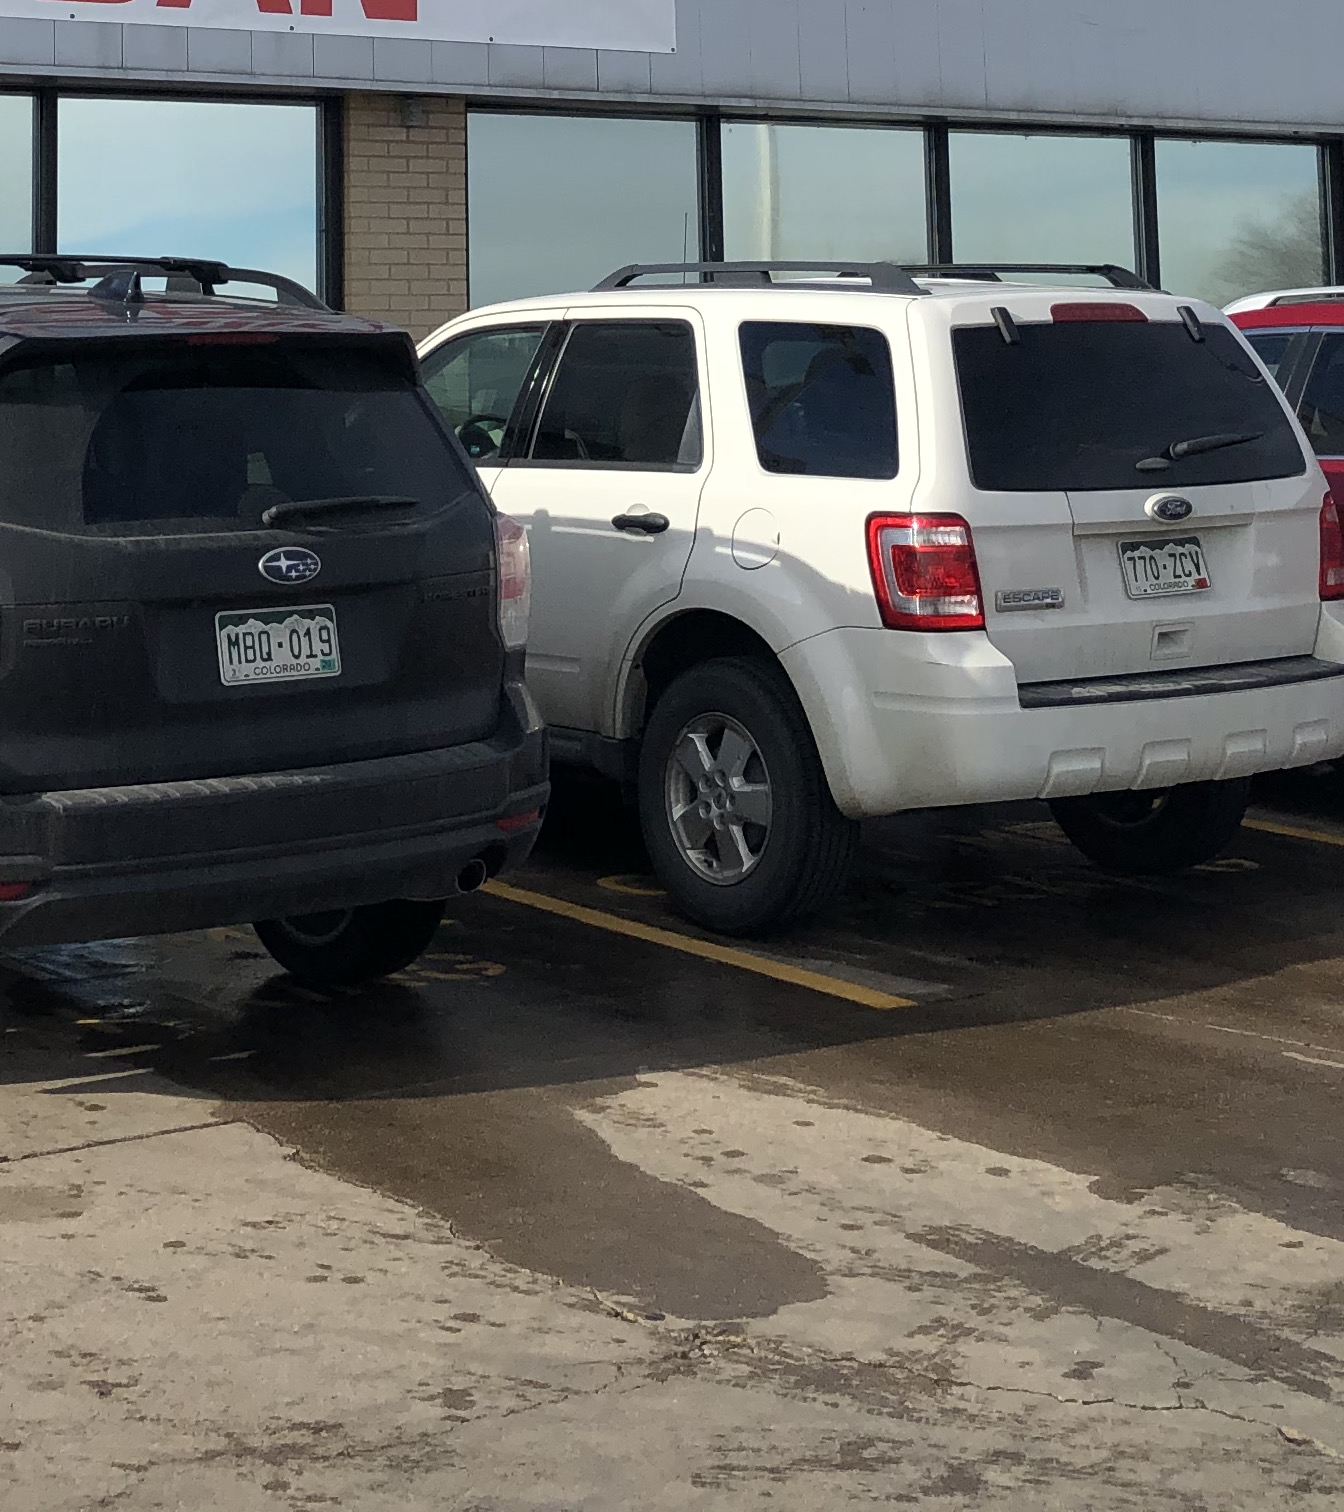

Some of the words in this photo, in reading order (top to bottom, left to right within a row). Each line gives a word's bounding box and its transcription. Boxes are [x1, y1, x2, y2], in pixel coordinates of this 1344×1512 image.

[1149, 580, 1189, 592] COLORADO
[1003, 589, 1060, 604] ESCAPE
[253, 662, 311, 676] COLORADO
